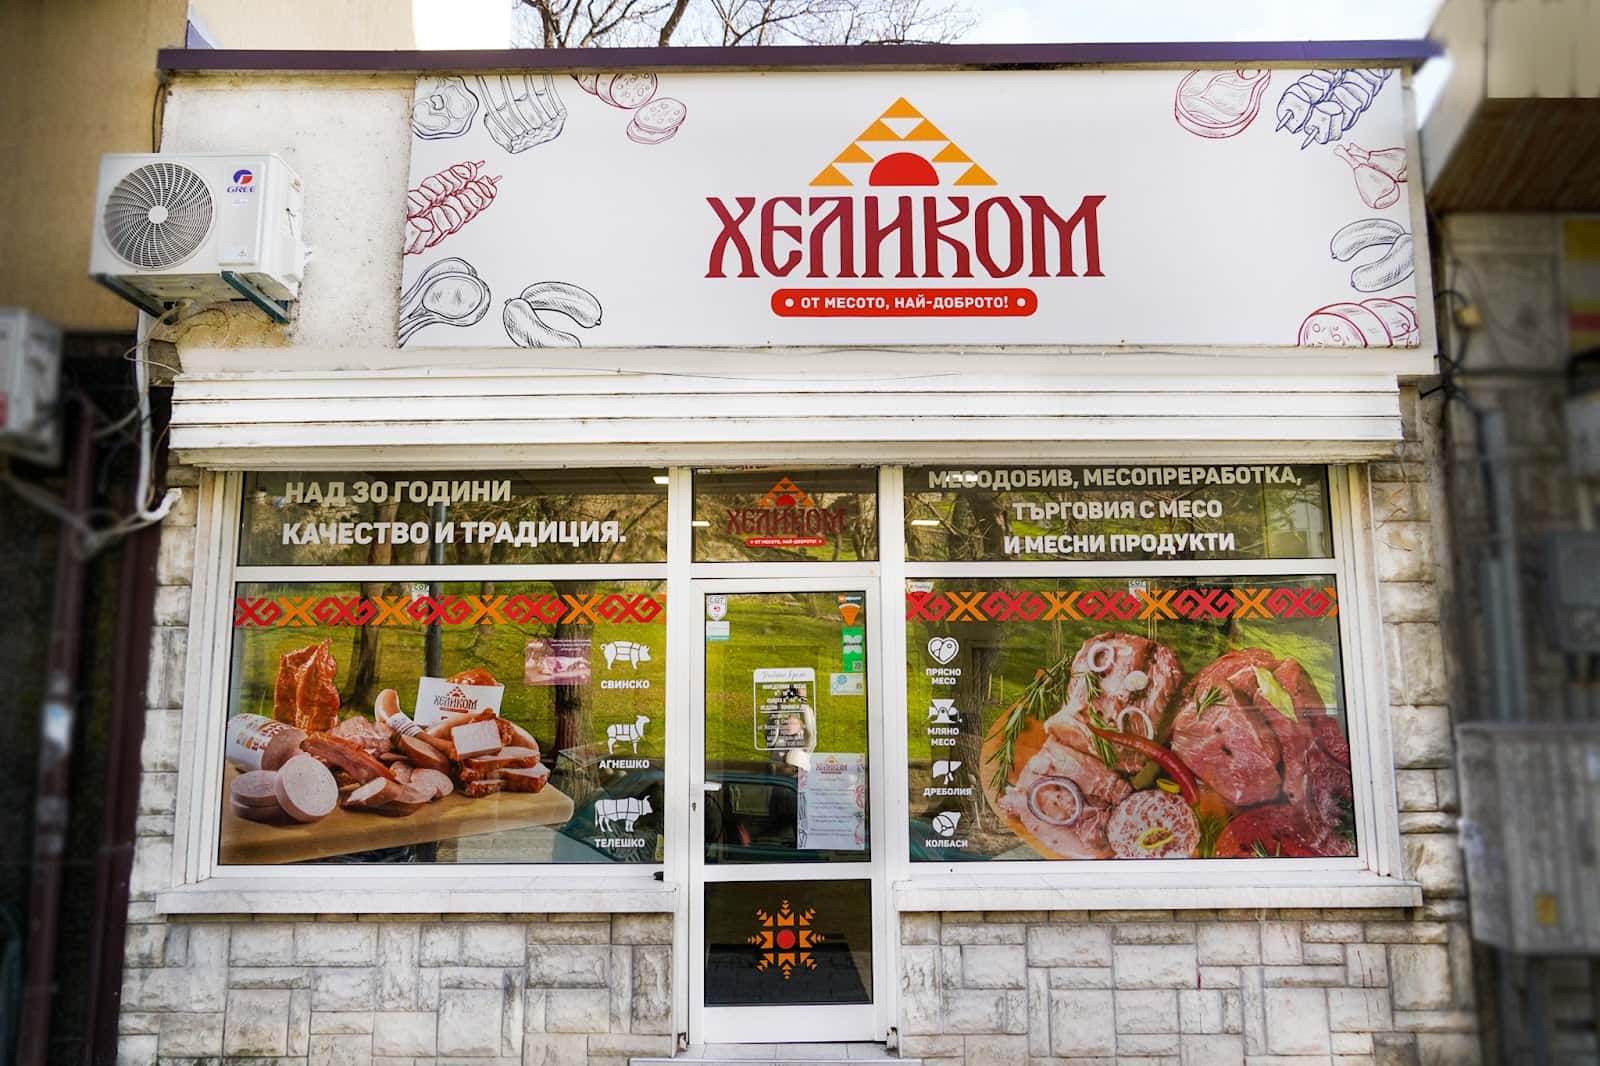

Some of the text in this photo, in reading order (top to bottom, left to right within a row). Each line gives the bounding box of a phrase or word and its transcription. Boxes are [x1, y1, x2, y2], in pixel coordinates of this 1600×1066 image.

[704, 195, 1107, 279] ХЕЛИКОМ
[800, 294, 1009, 310] ОТ МЕСОТО, НАЙ-ДОБРОТО!
[1083, 466, 1303, 487] МЕСОПРЕРАБОТКА,
[284, 480, 511, 506] НАД 30 ГОДИНИ
[1013, 499, 1223, 521] ТЪРГОВИЯ С МЕСО
[726, 508, 846, 534] ХЕЛИКОМ
[282, 520, 627, 547] КАЧЕСТВО И ТРАДИЦИЯ.
[1004, 533, 1236, 556] И МЕСНИ ПРОДУКТИ
[926, 668, 962, 676] ПРЯСНО
[600, 679, 650, 689] СВИНСКО
[931, 677, 957, 685] МЕСО
[927, 727, 960, 736] МЛЯНО
[931, 738, 956, 746] МЕСО
[599, 759, 650, 769] АГНЕШКО
[923, 787, 972, 797] ДРЕБОЛИЯ
[594, 838, 646, 849] ТЕЛЕШКО
[925, 839, 968, 848] КОЛБАСИ
